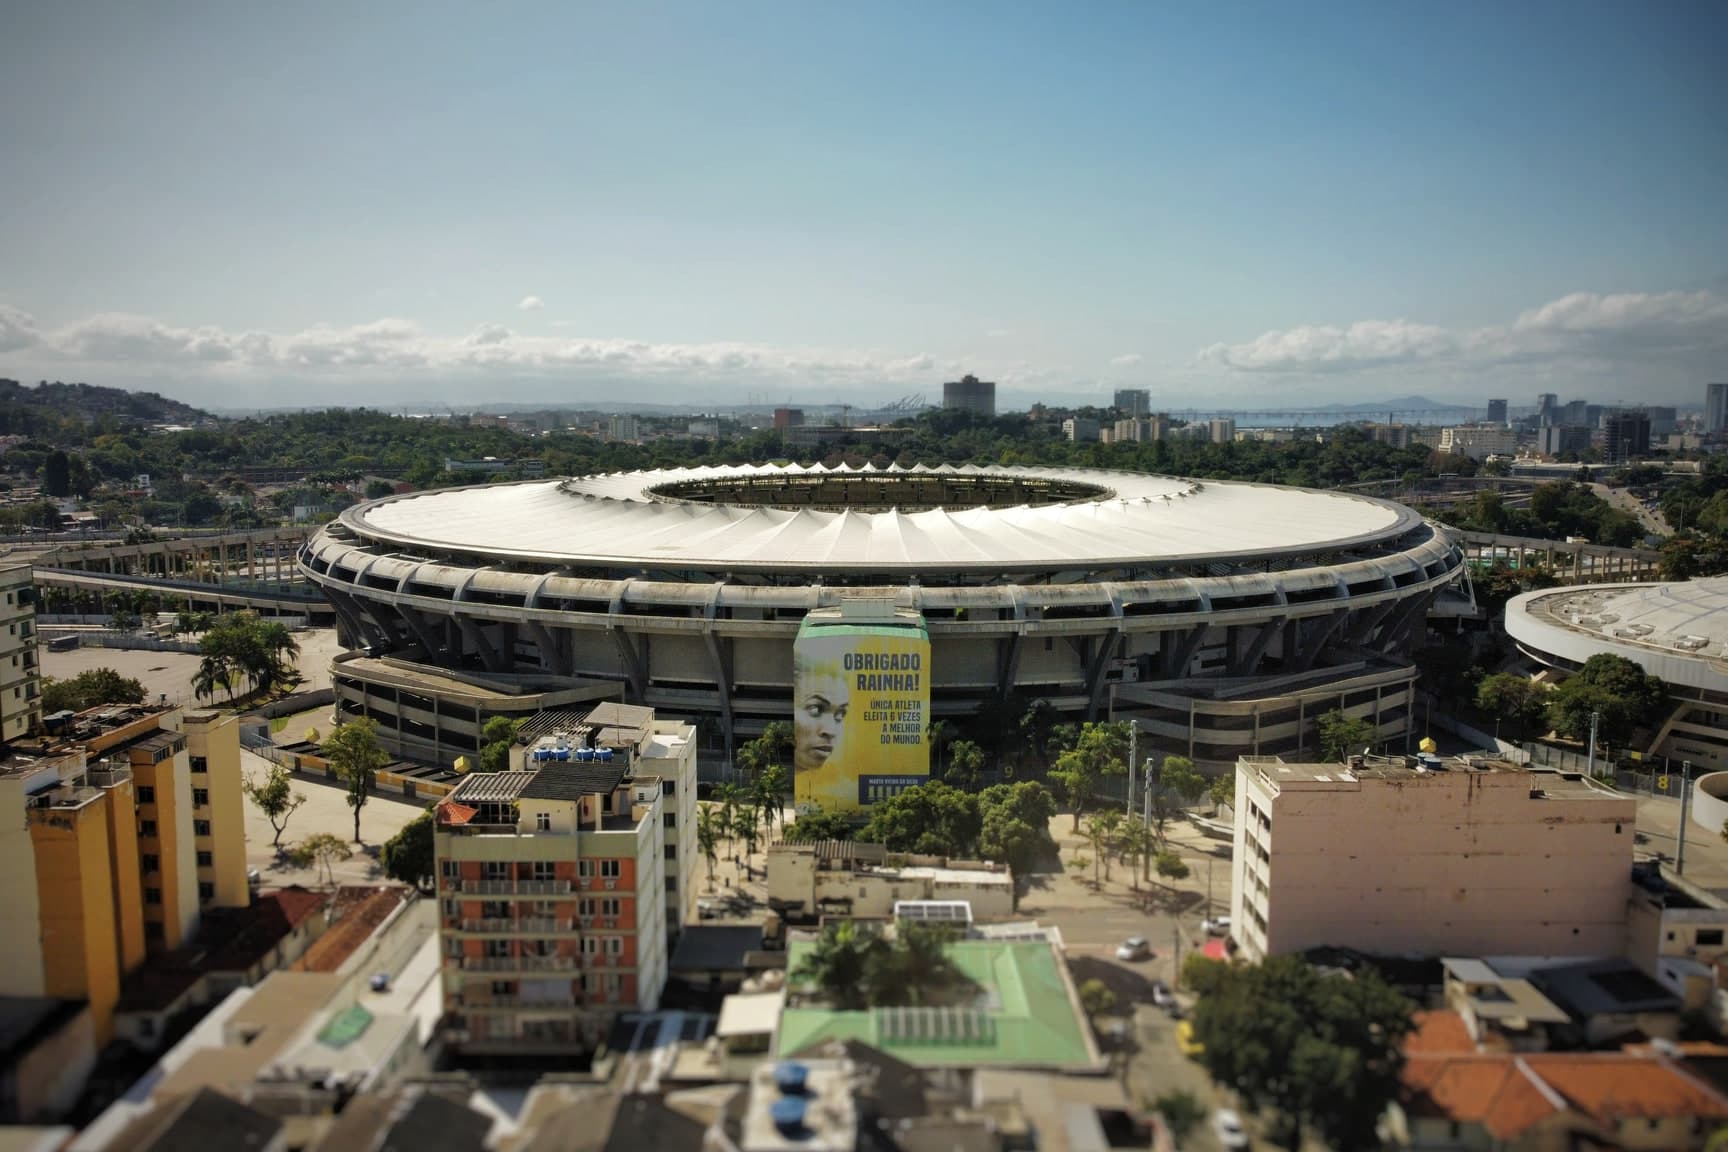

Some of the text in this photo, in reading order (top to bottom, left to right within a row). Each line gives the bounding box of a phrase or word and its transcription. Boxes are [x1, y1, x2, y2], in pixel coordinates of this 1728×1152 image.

[843, 652, 920, 671] OBRIGADO
[857, 673, 920, 691] RAINHA!
[895, 700, 921, 710] ATLETA
[863, 711, 888, 721] ELEITA
[897, 711, 921, 722] VEZES
[882, 723, 921, 733] A MELHOR
[880, 734, 891, 745] DO
[1658, 775, 1669, 789] 8
